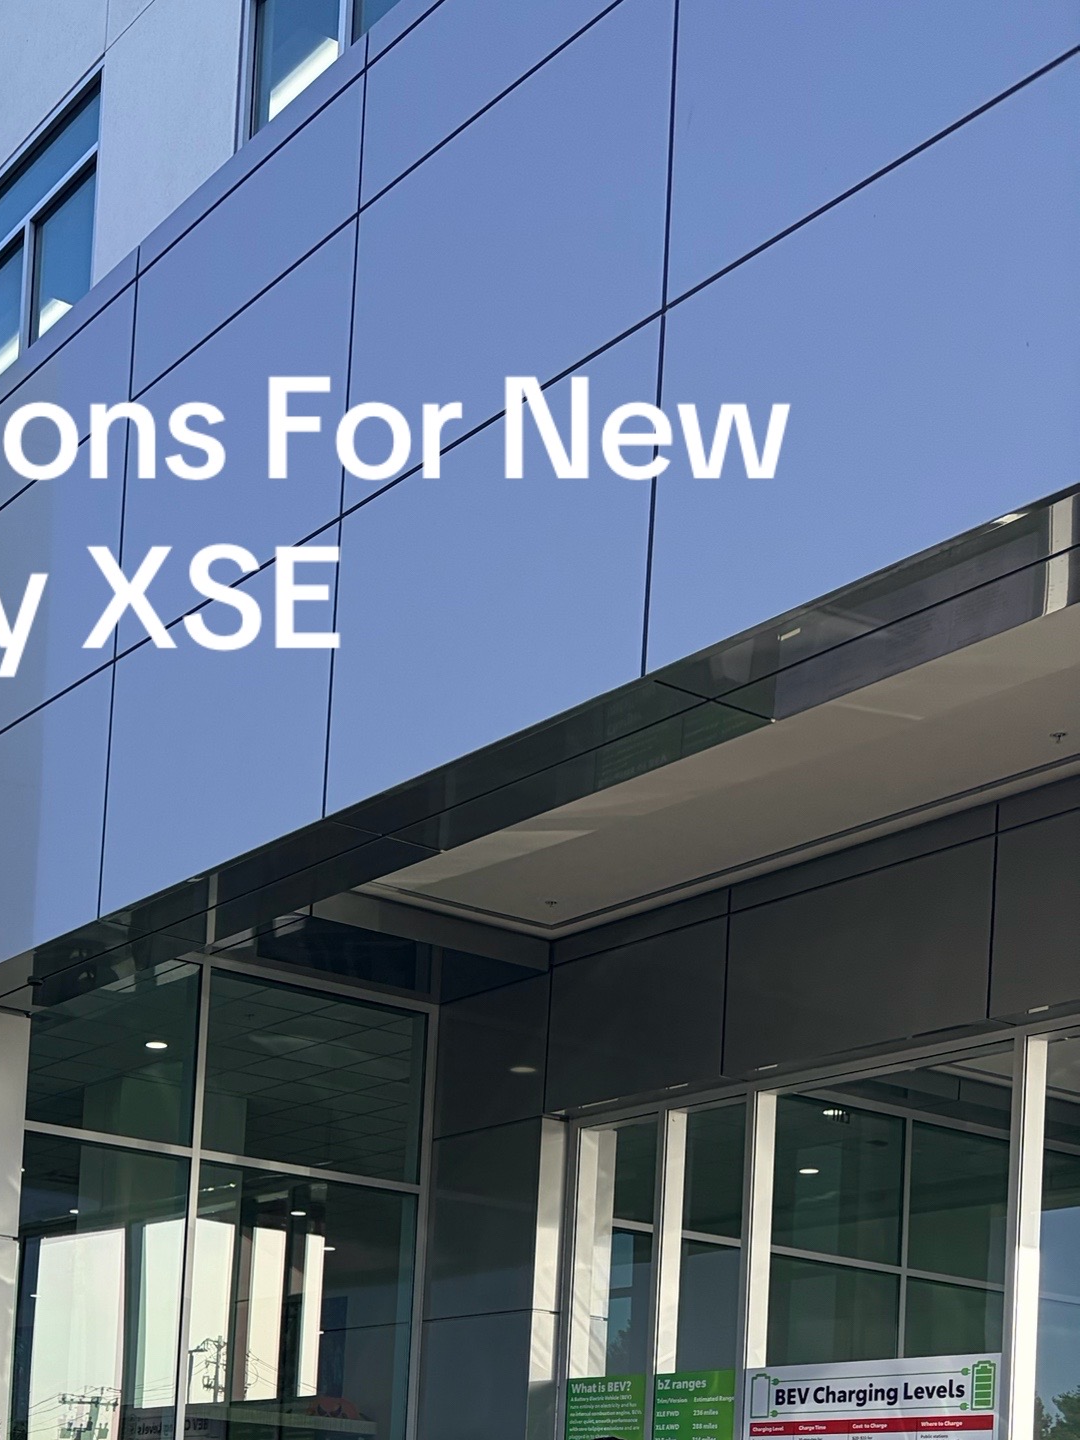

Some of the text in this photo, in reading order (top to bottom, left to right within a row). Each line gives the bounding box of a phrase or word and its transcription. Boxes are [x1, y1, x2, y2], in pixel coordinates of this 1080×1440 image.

[571, 1381, 632, 1394] What is BEV?
[657, 1379, 707, 1391] bZ ranges
[775, 1379, 965, 1407] BEV Charging Levels
[665, 1423, 680, 1431] AWD
[870, 1422, 888, 1430] Charge
[944, 1419, 963, 1427] Charge
